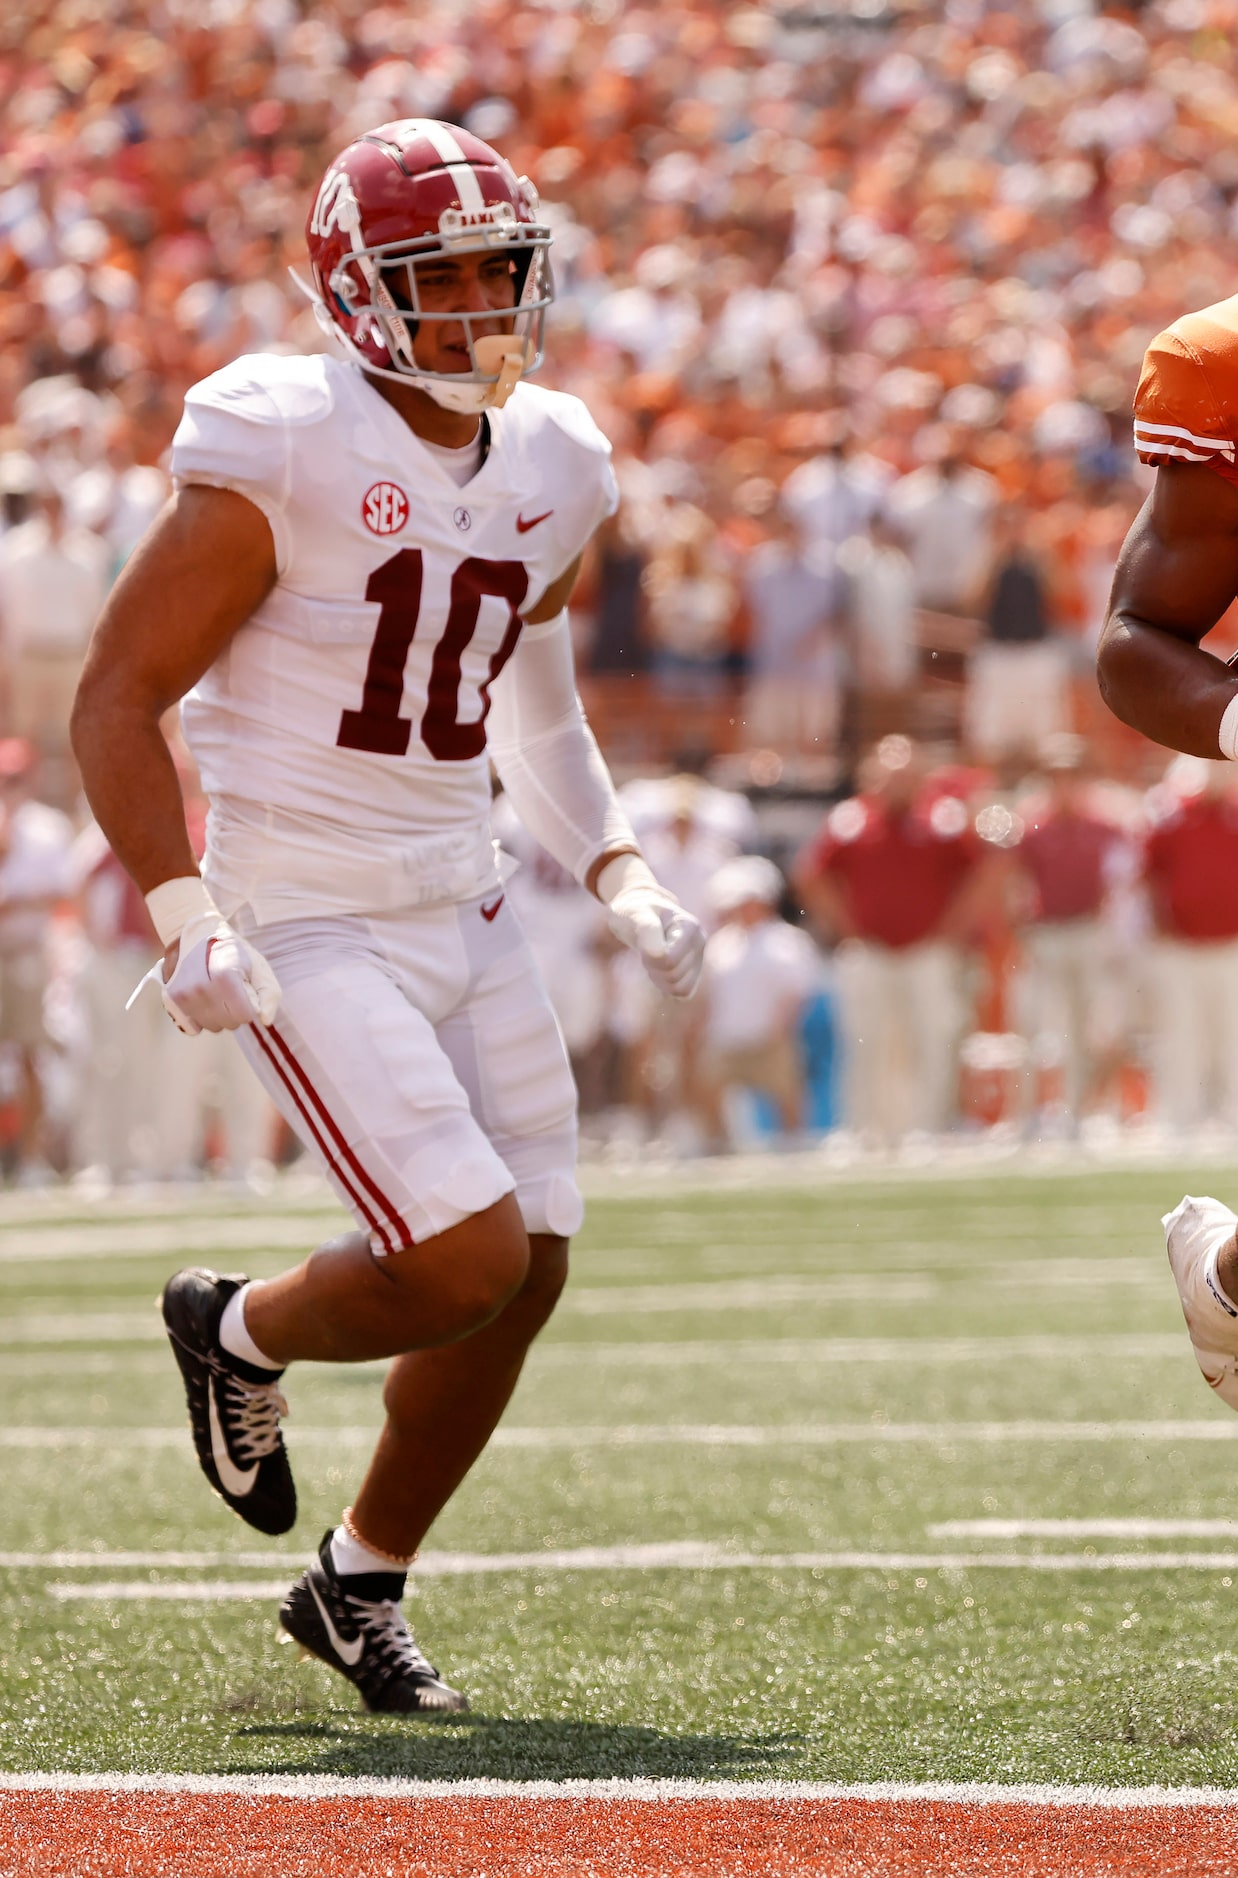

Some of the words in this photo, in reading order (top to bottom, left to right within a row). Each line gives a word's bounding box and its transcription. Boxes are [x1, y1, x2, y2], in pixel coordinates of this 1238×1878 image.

[461, 213, 495, 227] BAMA
[363, 482, 408, 534] SEC
[336, 547, 528, 760] 10
